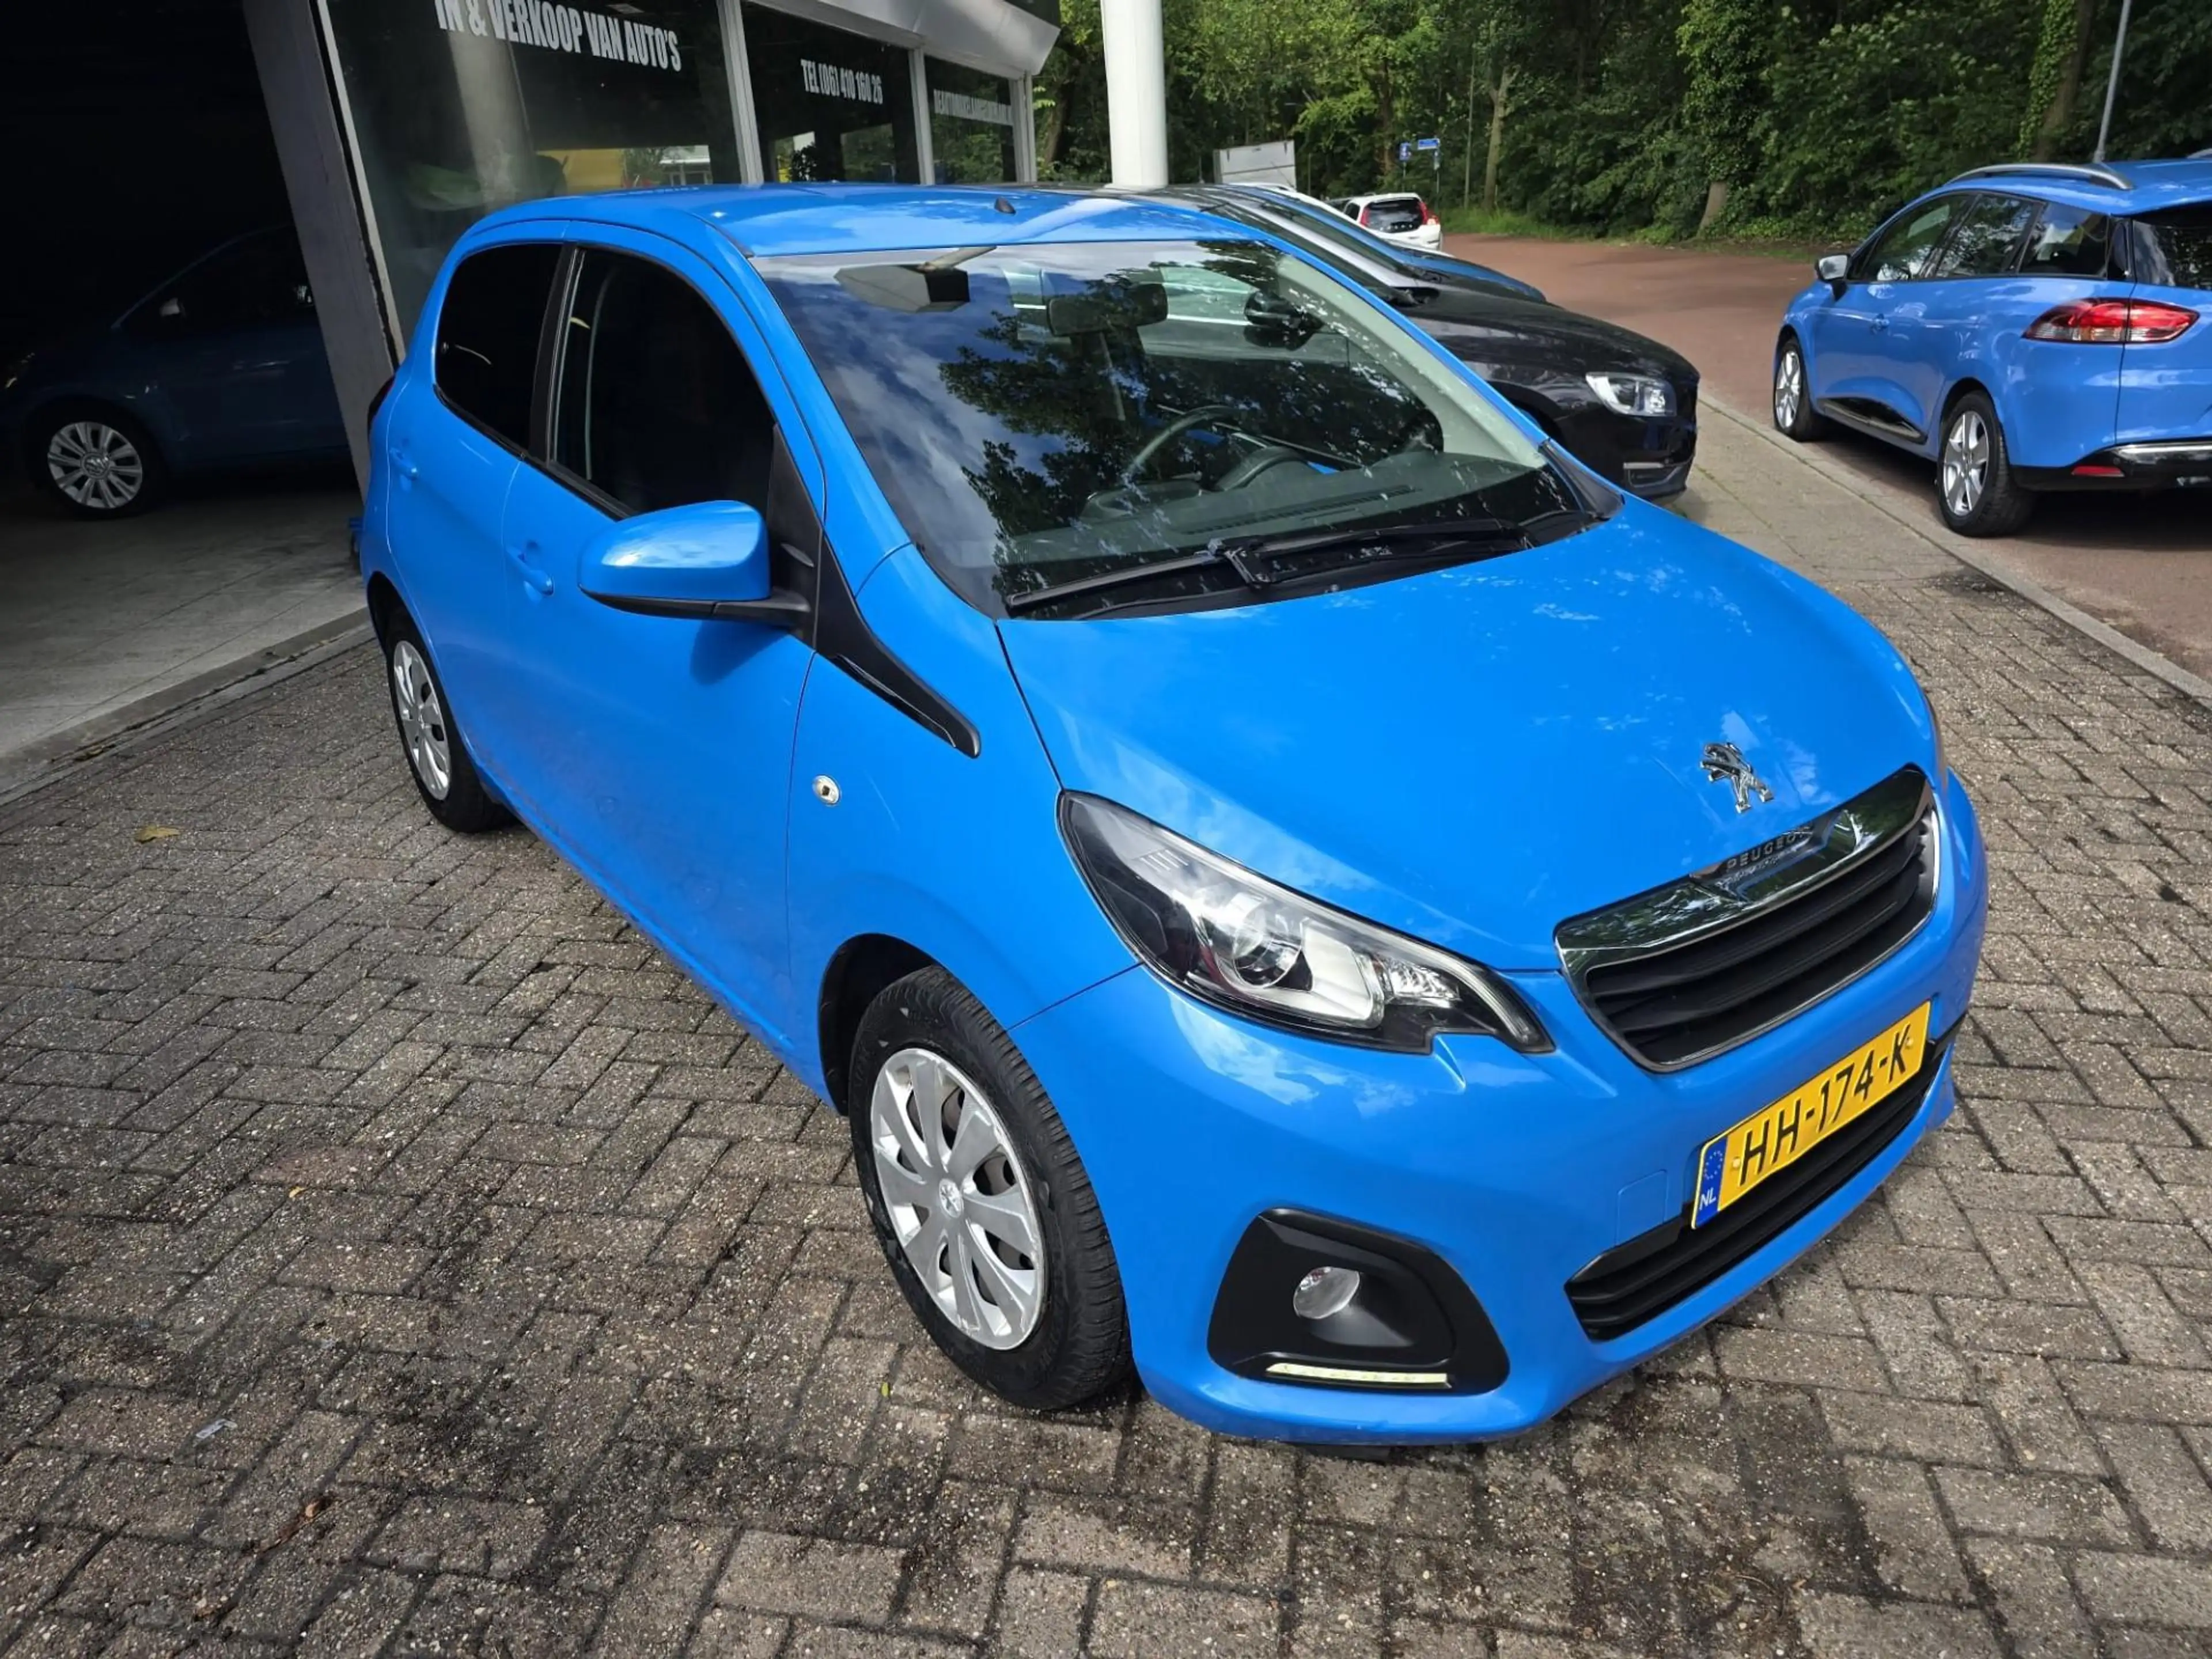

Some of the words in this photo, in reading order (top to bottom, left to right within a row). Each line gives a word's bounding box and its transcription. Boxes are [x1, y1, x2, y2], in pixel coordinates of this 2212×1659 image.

[434, 0, 464, 32] IN
[487, 0, 583, 54] VERKOOP
[583, 10, 624, 61] VAN
[624, 20, 681, 71] AUTO'S
[801, 59, 819, 93] TEL
[1726, 826, 1810, 870] PEUGEOT
[1738, 1024, 1911, 1187] HH-174-K
[1699, 1187, 1717, 1210] NL
